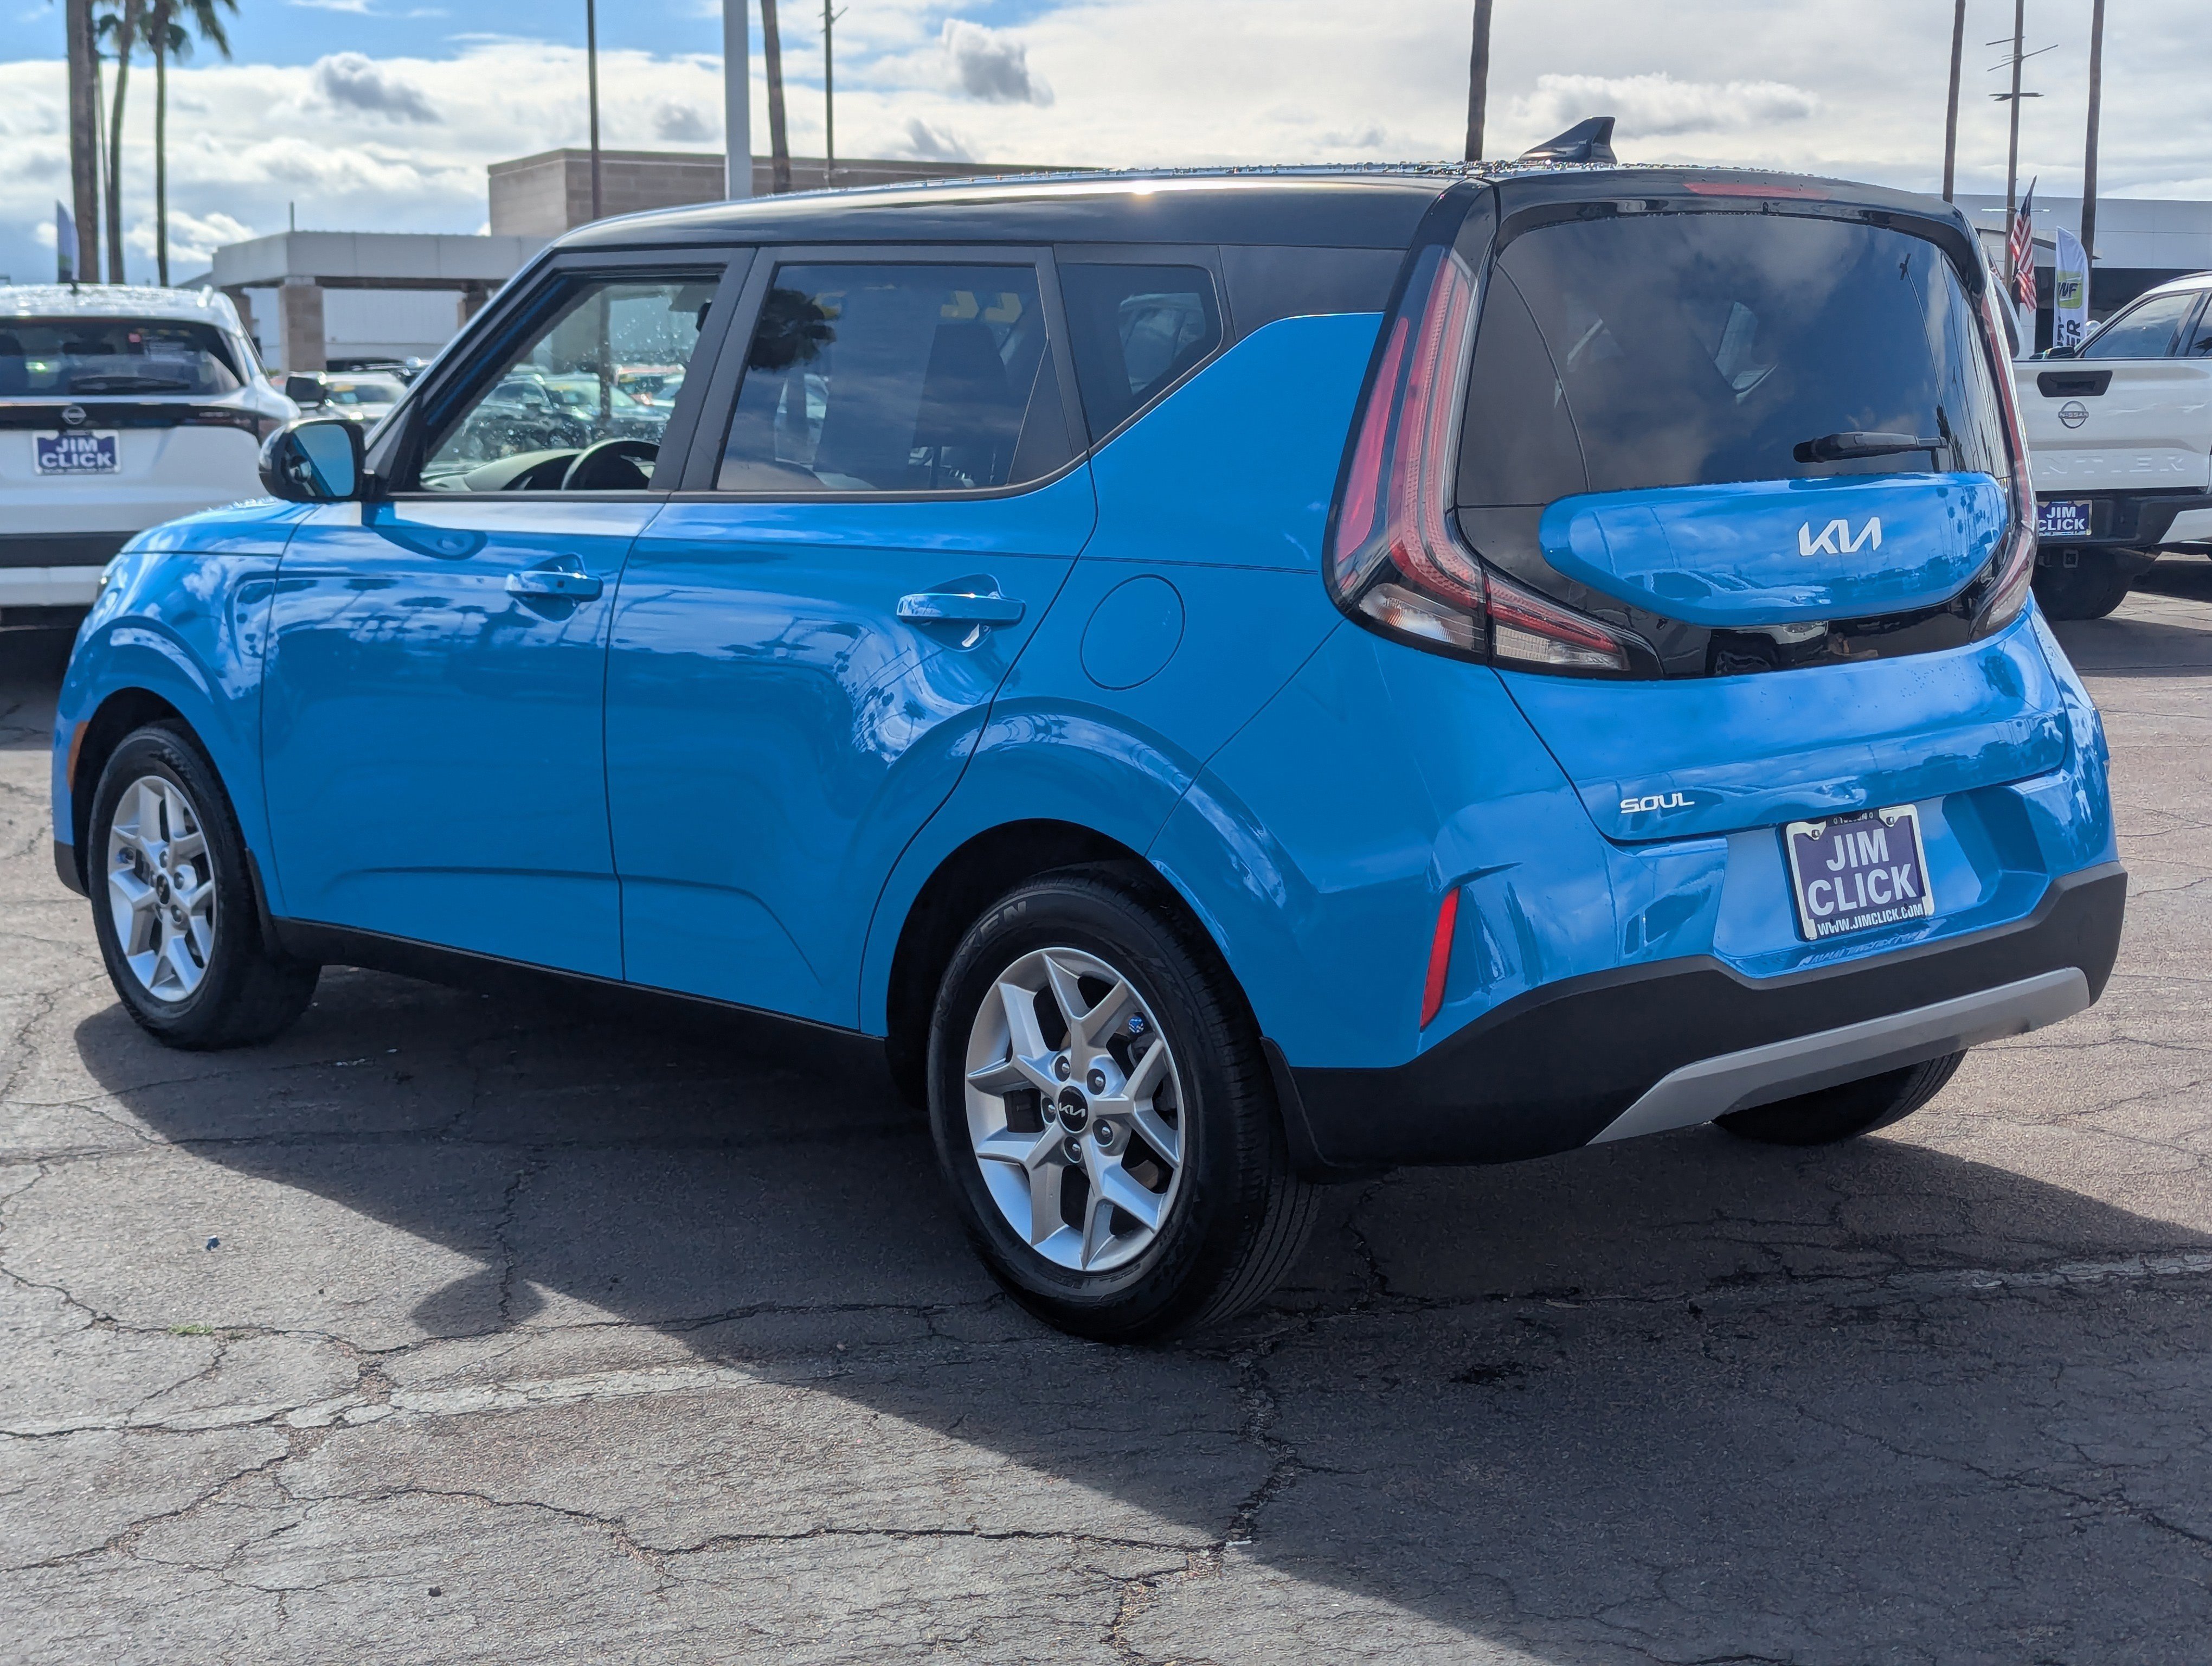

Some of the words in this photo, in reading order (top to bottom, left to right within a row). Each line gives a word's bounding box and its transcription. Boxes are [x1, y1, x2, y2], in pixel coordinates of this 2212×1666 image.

[55, 437, 98, 452] JIM
[41, 452, 112, 467] CLICK
[2042, 454, 2185, 475] NTIER
[2046, 507, 2076, 518] JIM
[2039, 518, 2085, 531] CLICK
[1798, 517, 1882, 556] KIA
[1620, 792, 1695, 814] SOUL
[1826, 828, 1889, 872] JIM
[1808, 863, 1917, 916] CLICK
[1059, 1102, 1086, 1118] KIA
